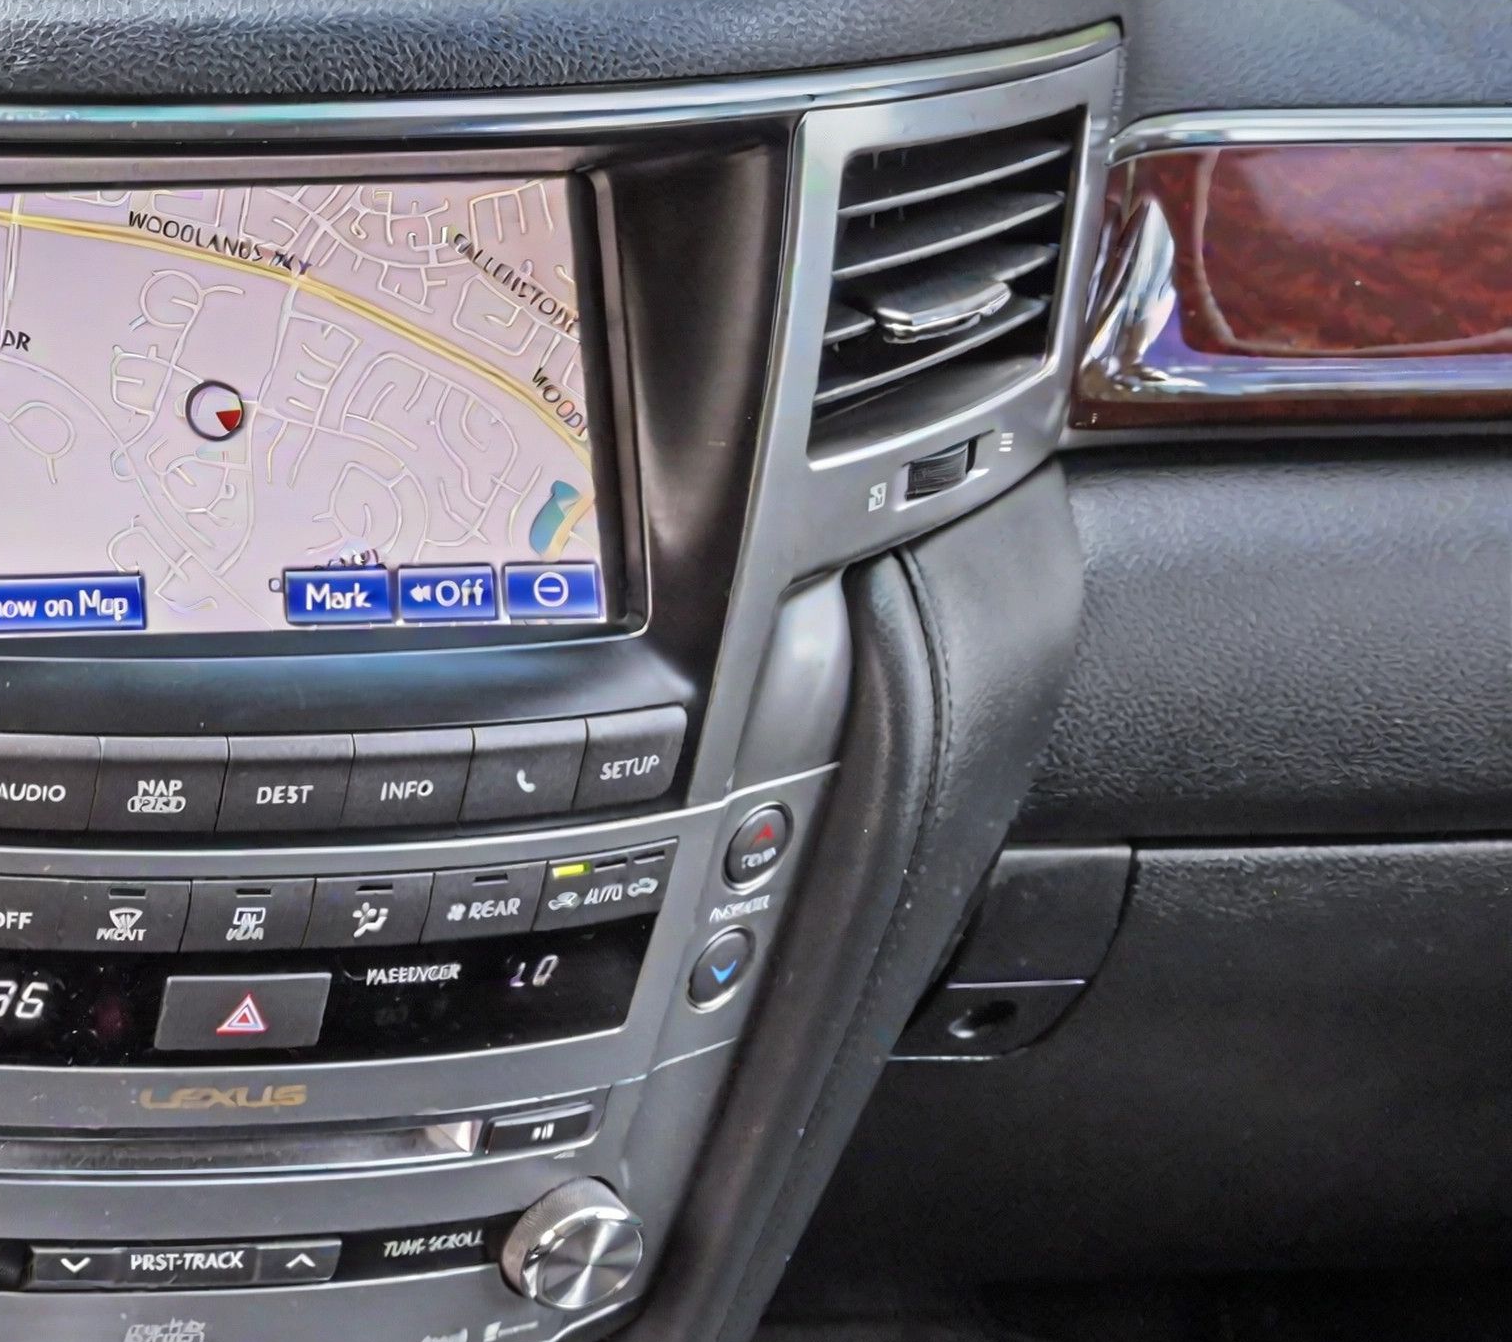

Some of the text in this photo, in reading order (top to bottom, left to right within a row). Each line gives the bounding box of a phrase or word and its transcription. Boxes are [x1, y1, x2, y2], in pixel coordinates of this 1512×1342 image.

[44, 597, 73, 617] on
[79, 590, 129, 622] Map
[305, 582, 372, 610] Mark
[435, 578, 485, 608] Off
[599, 754, 661, 782] SETUP
[256, 784, 314, 805] DEST
[380, 779, 434, 802] INFO
[468, 897, 521, 919] REAR
[139, 1083, 309, 1110] LEXUS
